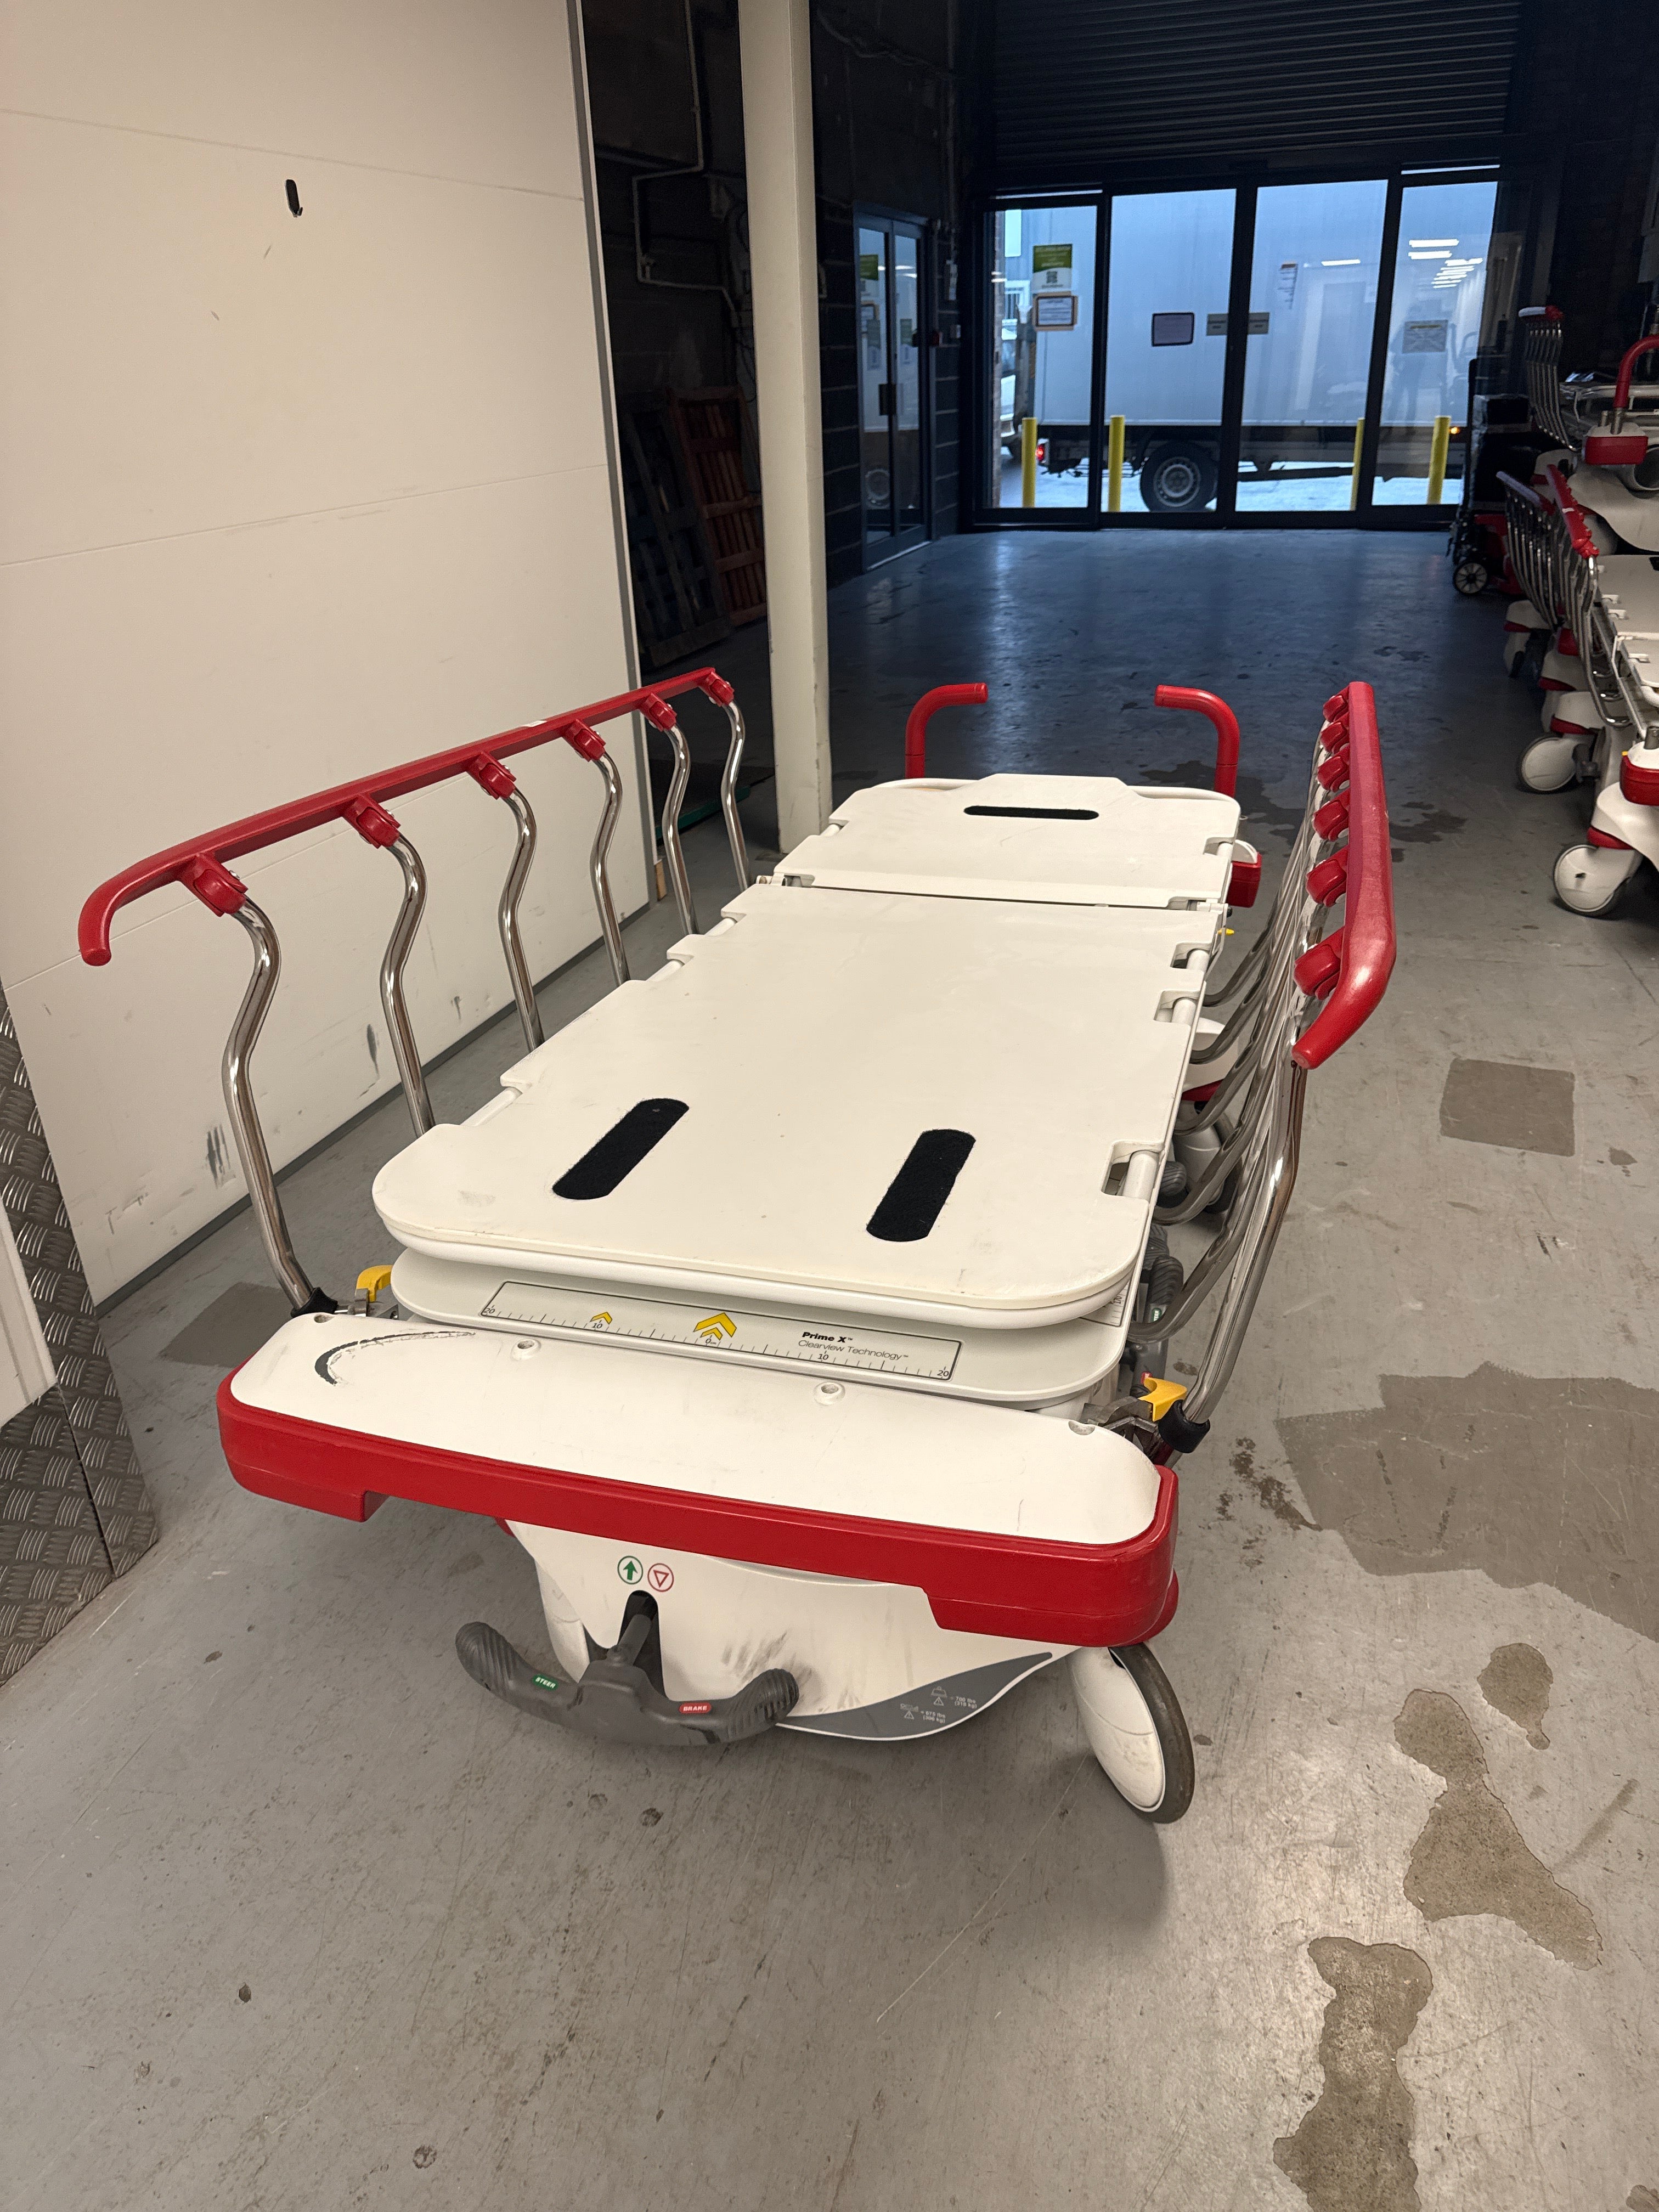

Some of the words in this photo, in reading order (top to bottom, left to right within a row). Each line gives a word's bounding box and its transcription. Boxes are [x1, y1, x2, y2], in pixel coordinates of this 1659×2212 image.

[802, 1331, 835, 1341] Prime
[798, 1340, 845, 1352] Clearview
[535, 1677, 556, 1689] STEER
